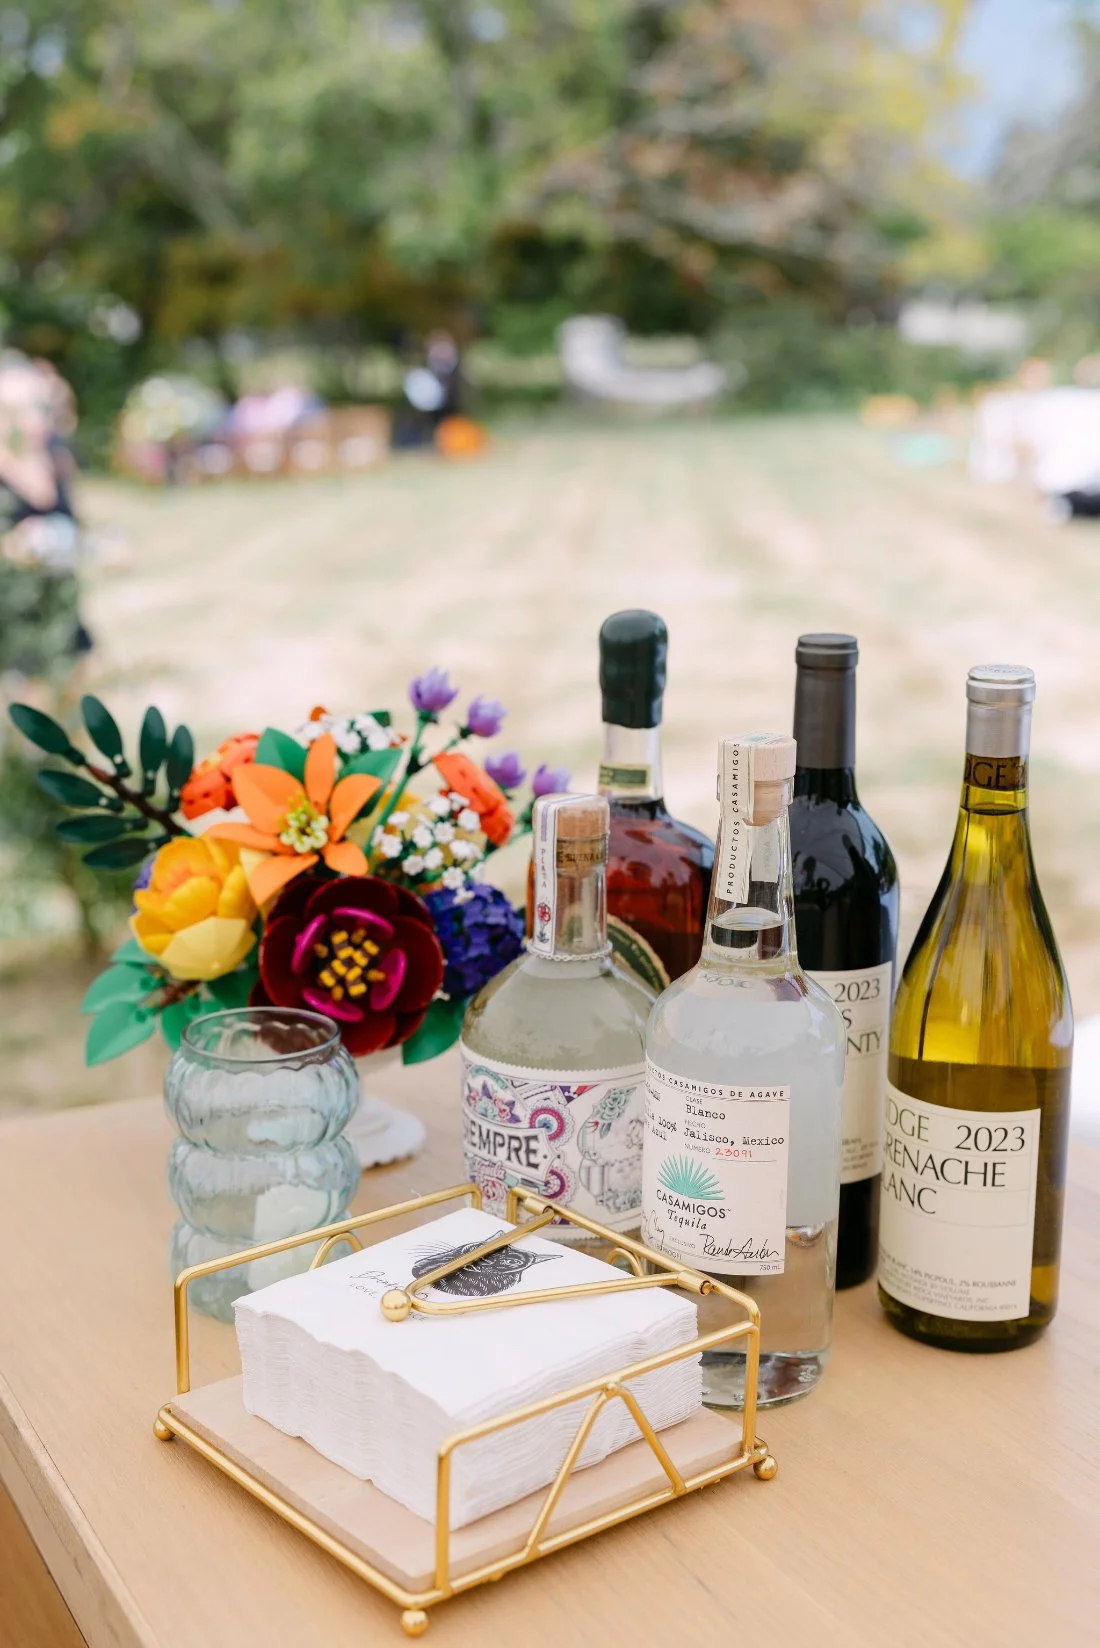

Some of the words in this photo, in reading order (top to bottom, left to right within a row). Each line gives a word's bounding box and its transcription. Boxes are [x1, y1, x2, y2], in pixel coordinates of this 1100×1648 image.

[732, 743, 740, 813] CASAMIGOS
[726, 820, 740, 895] PRODUCTOS
[834, 978, 880, 1003] 2023
[669, 1077, 723, 1096] CASAMIGOS
[730, 1090, 743, 1098] DE
[750, 1090, 785, 1098] AGAVE
[685, 1104, 726, 1120] Blanco
[464, 1118, 541, 1170] EMPRE
[684, 1127, 735, 1147] Jalisco,
[743, 1136, 785, 1146] Mexico
[955, 1125, 1025, 1152] 2023
[715, 1147, 752, 1159] 23091
[656, 1189, 727, 1219] CASAMIGOS
[667, 1209, 708, 1231] Tequila
